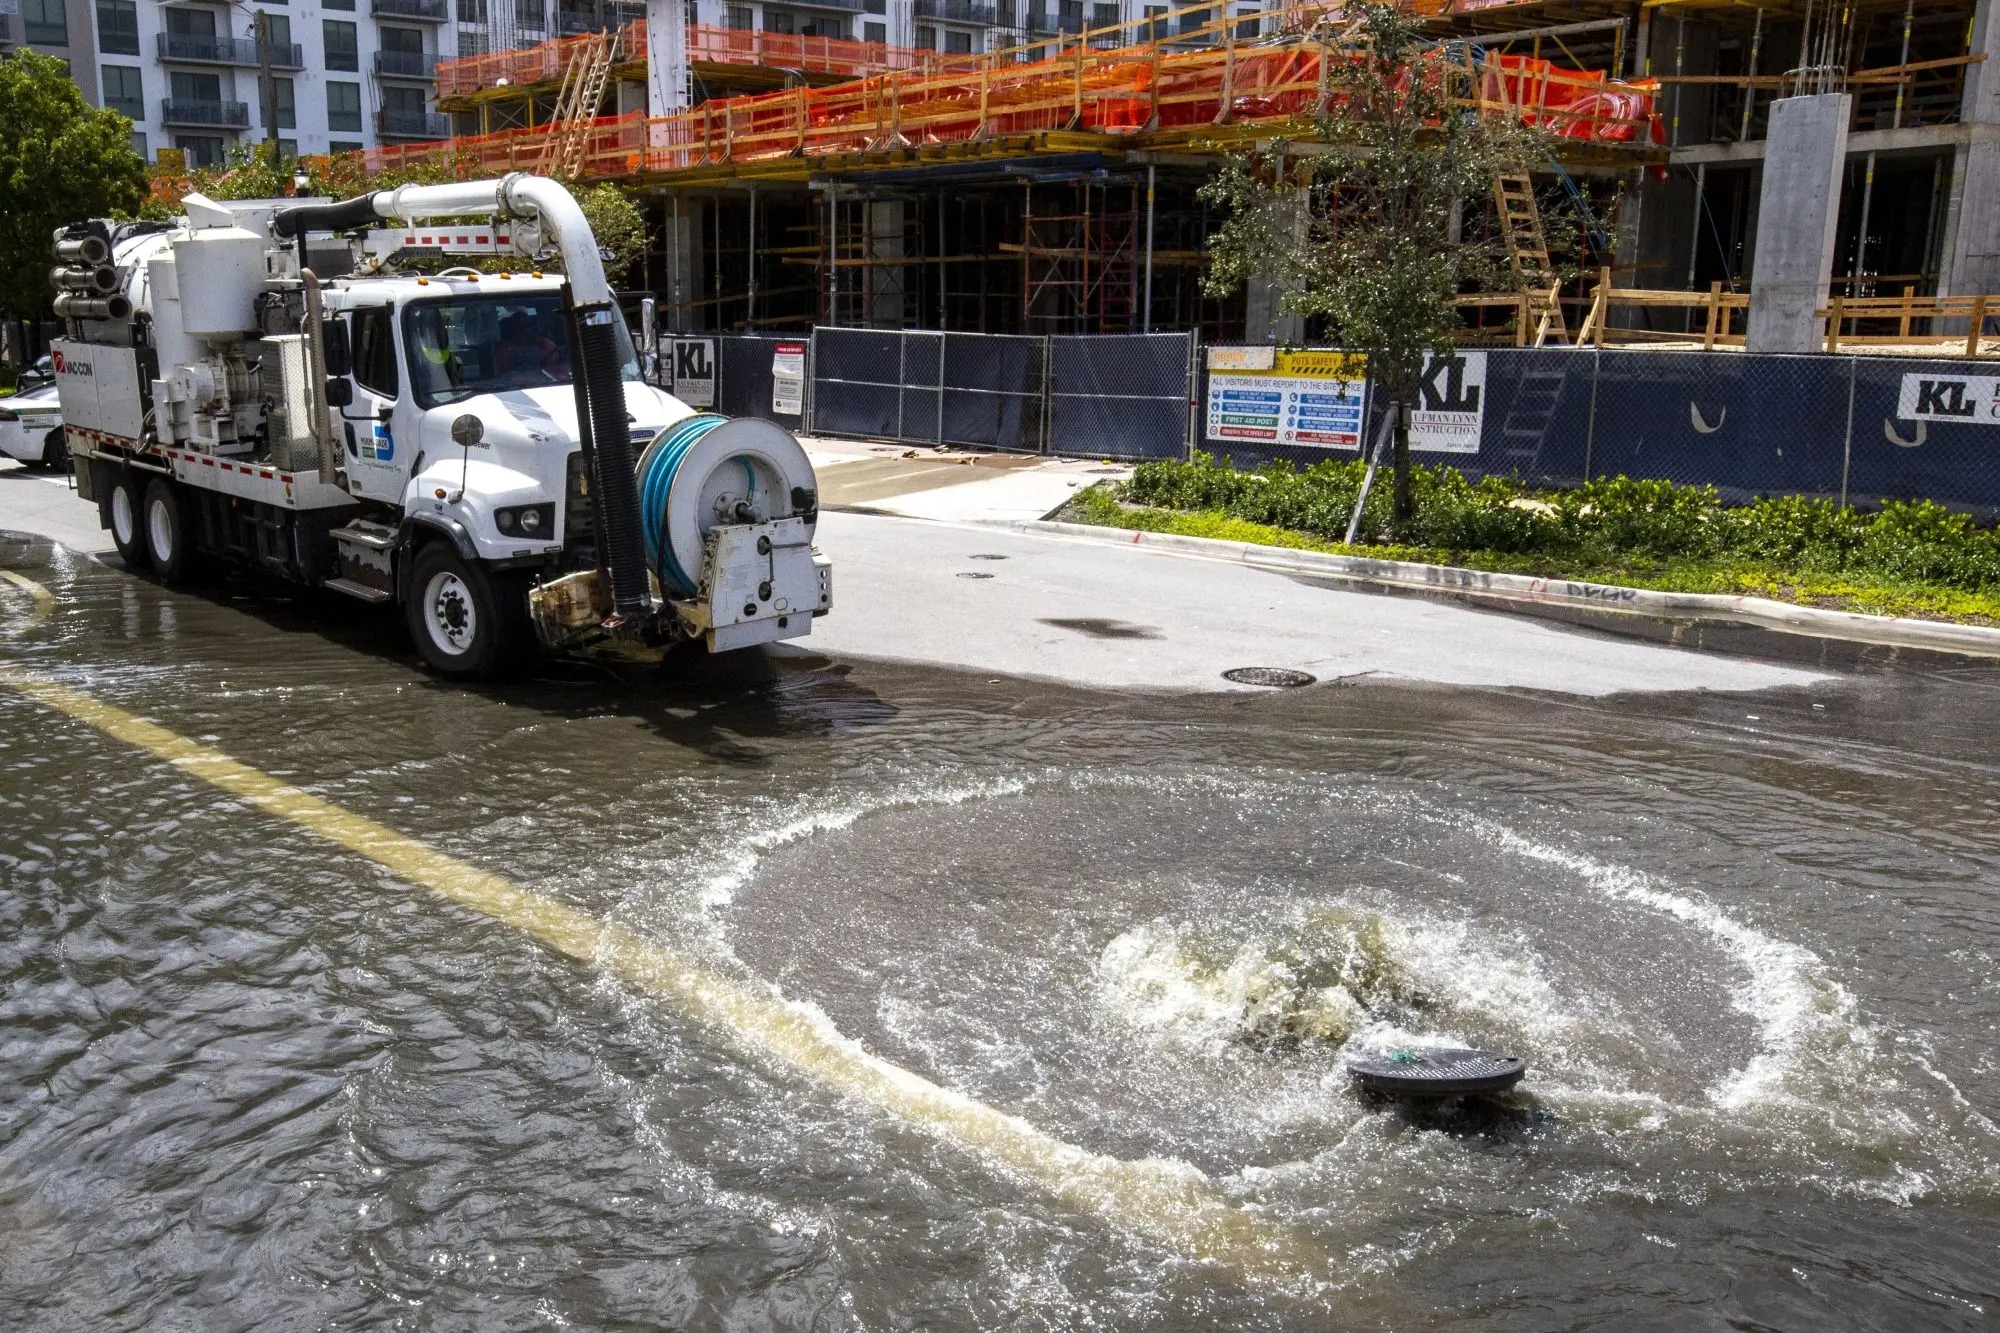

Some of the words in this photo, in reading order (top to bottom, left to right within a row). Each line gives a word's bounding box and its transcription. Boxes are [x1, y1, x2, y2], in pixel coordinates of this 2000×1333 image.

[676, 342, 712, 380] KL
[1292, 356, 1310, 366] PUTS
[1312, 357, 1337, 366] SAFETY
[1212, 378, 1224, 386] ALL
[1225, 378, 1253, 386] VISITORS
[1254, 379, 1272, 387] MUST
[1272, 380, 1298, 389] REPORT
[1300, 382, 1310, 390] TO
[1310, 382, 1322, 390] THE
[1324, 382, 1337, 391] SITE
[1338, 383, 1361, 392] FICE
[1410, 356, 1480, 412] KL
[1915, 380, 1976, 416] KL
[1413, 414, 1449, 422] UFMAN
[1452, 414, 1477, 424] LYNN
[1413, 424, 1476, 434] NSTRUCTION
